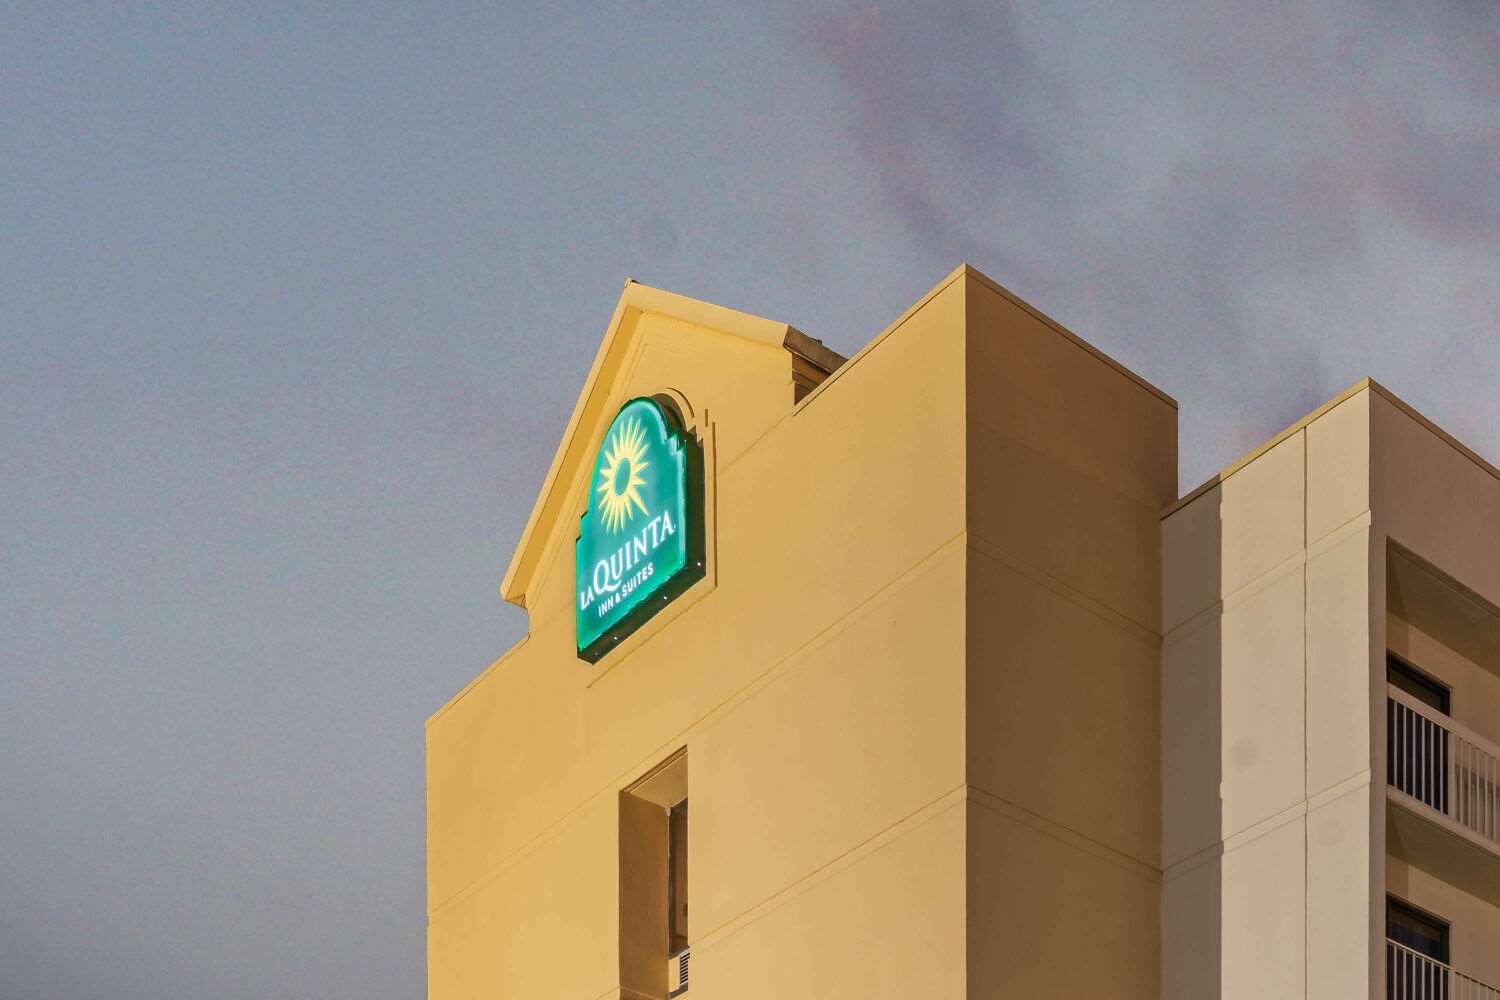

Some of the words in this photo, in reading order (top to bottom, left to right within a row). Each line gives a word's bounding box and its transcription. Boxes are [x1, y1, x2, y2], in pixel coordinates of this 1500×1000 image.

[580, 586, 594, 611] LA
[593, 510, 675, 594] QUINTA
[598, 595, 614, 618] INN
[615, 592, 621, 603] &
[622, 562, 654, 597] SUITES
